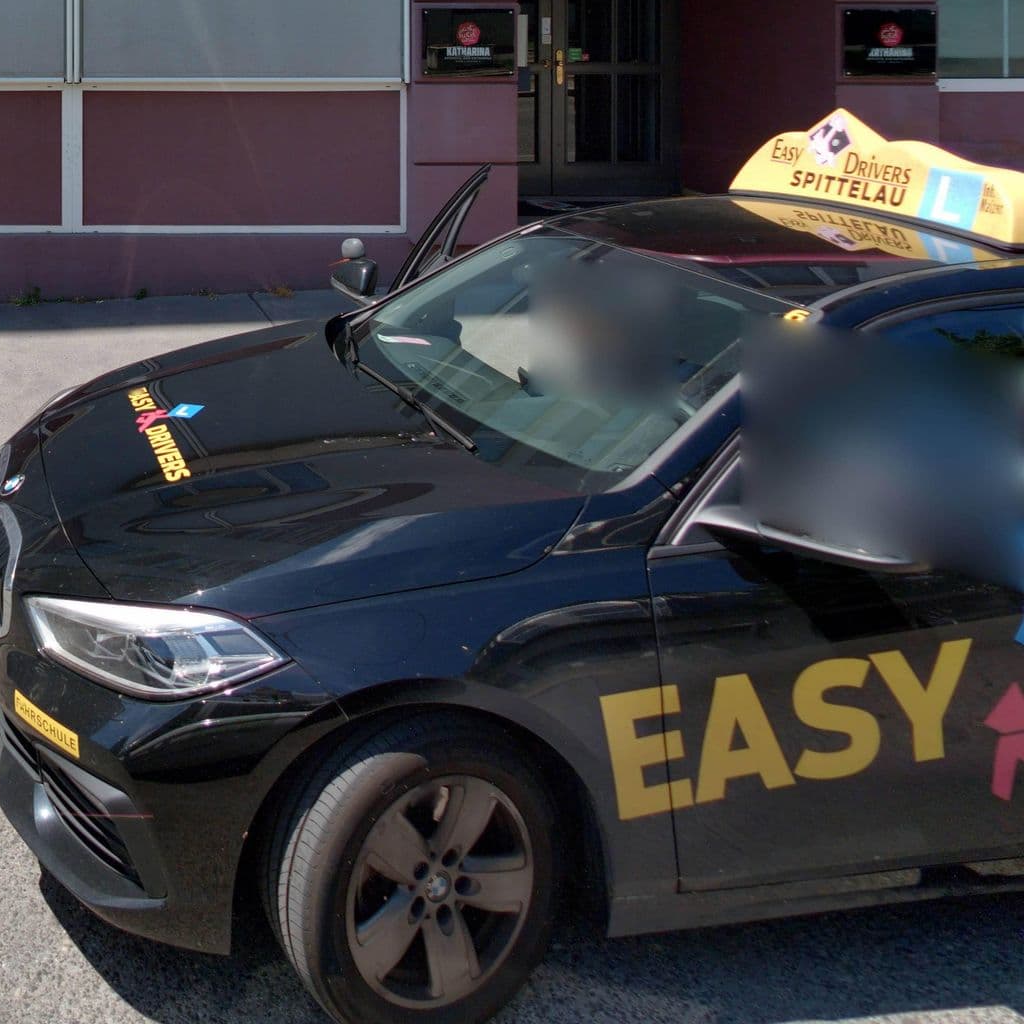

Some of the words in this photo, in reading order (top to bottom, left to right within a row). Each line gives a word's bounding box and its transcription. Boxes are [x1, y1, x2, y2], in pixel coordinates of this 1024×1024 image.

[446, 46, 491, 57] KATHARINA
[790, 170, 907, 207] SPITTELAU
[930, 175, 960, 224] L
[144, 424, 191, 482] DRIVERS
[16, 697, 77, 750] FAHRSCHULE
[600, 638, 973, 821] EASY
